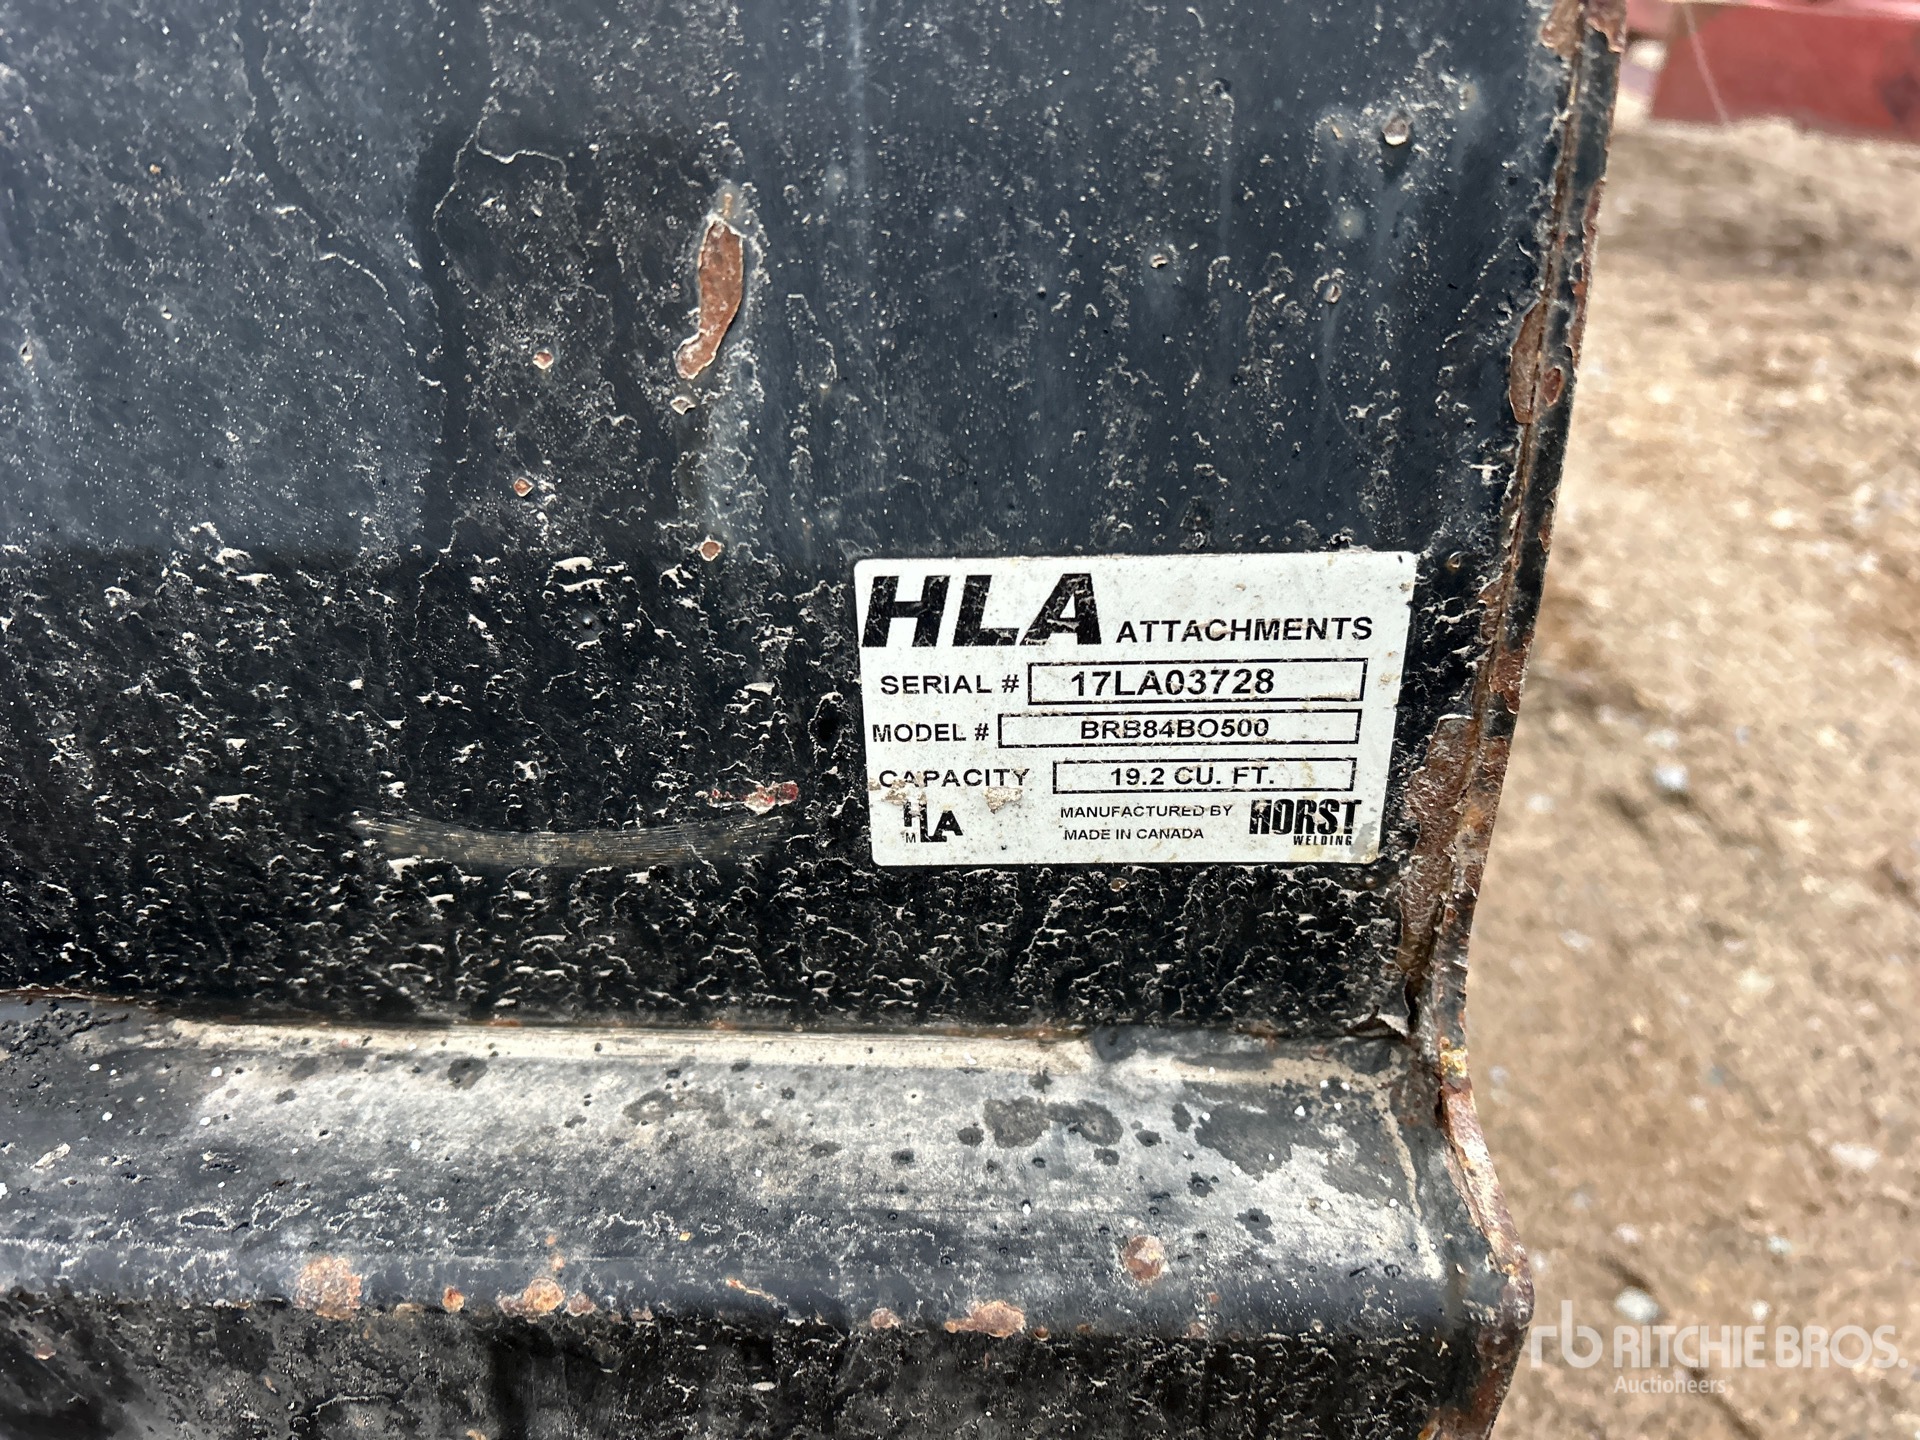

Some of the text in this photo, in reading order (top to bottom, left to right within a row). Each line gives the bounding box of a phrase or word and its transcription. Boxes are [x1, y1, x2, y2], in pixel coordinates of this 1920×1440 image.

[861, 573, 1373, 648] HLA ATTACHMENTS
[880, 674, 1020, 695] SERIAL #
[1071, 668, 1275, 697] 17LA03728
[872, 722, 990, 743] MODEL #
[879, 768, 1030, 788] CAPACITY
[1110, 766, 1276, 786] 19.2 CU. FT.
[1060, 805, 1233, 819] MANUFACTURED BY
[1250, 799, 1362, 835] HORST
[1064, 828, 1205, 841] MADE IN CANADA
[1293, 835, 1353, 846] WELDING
